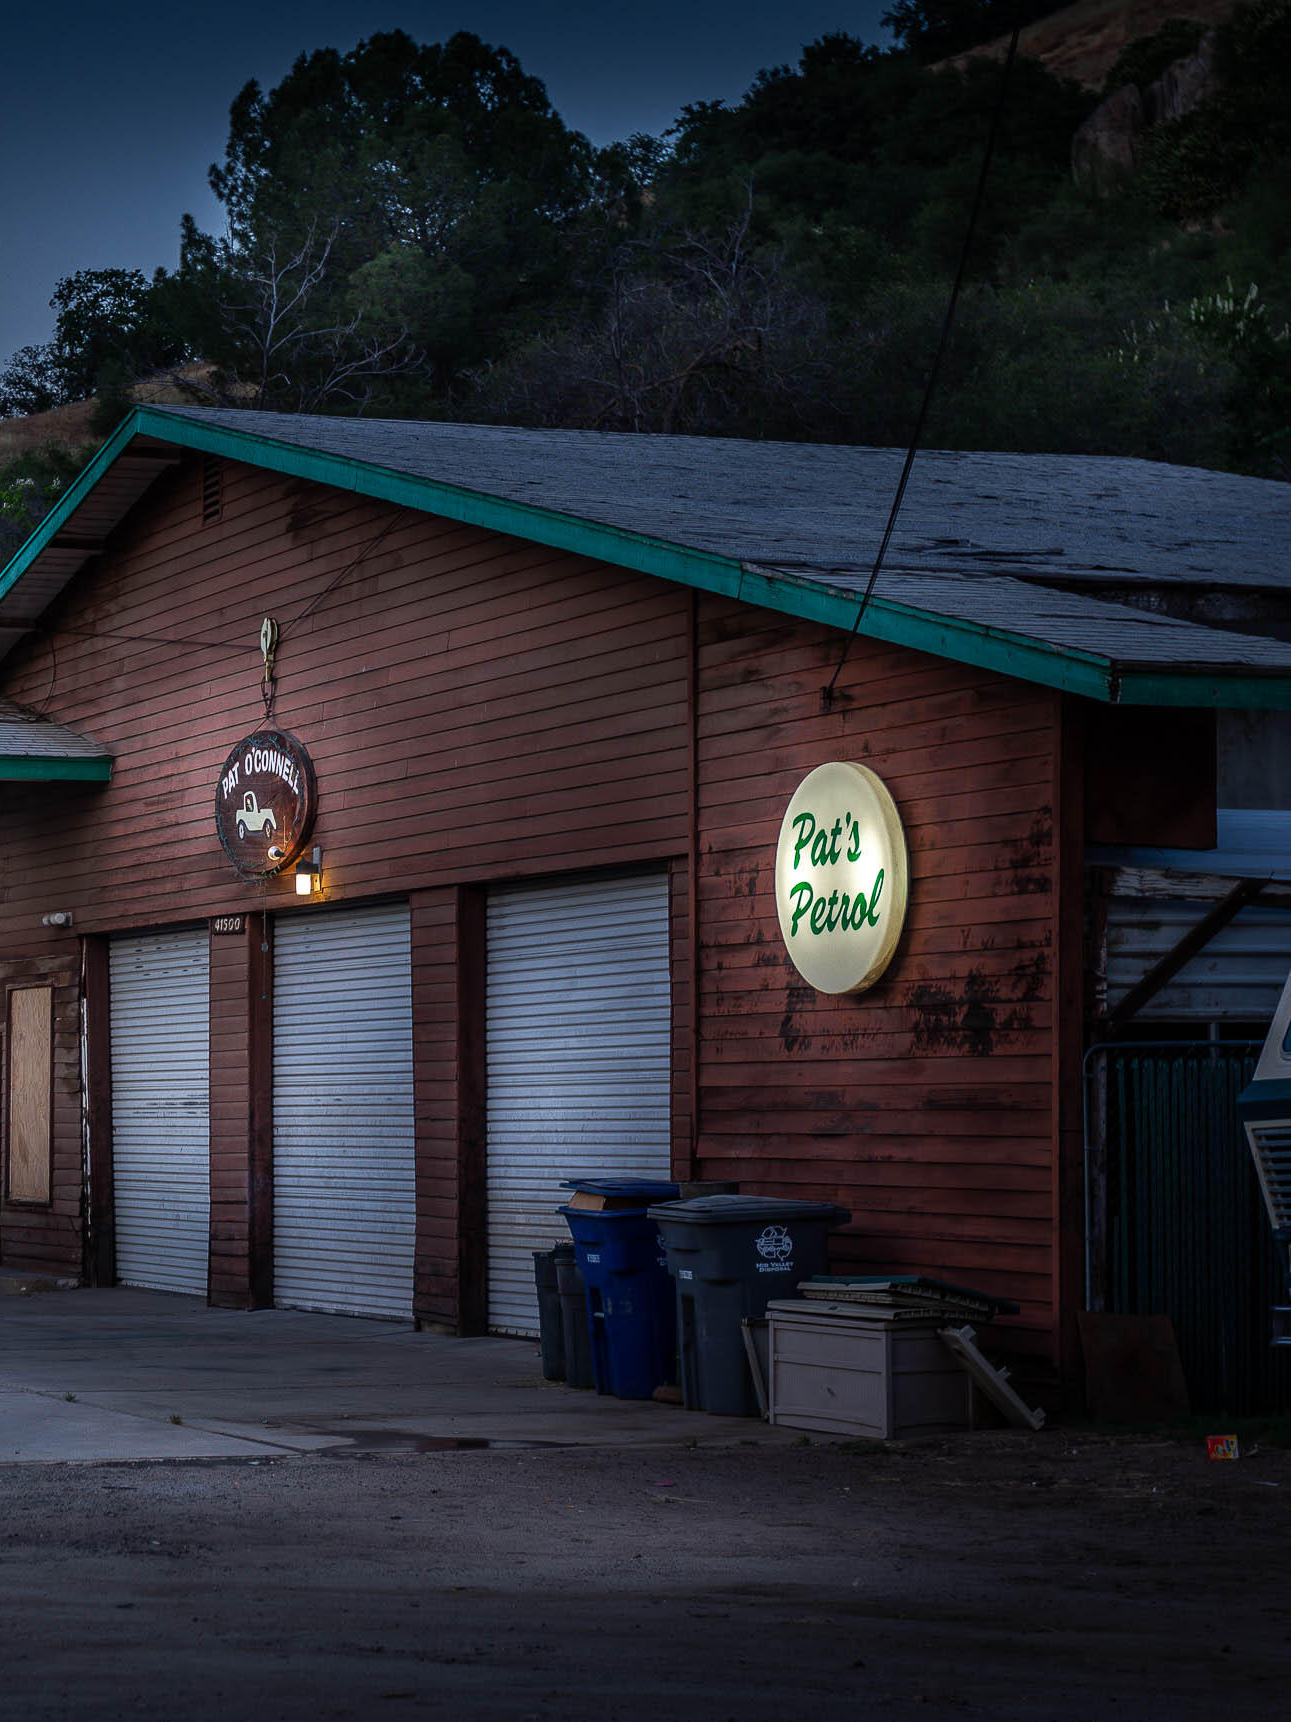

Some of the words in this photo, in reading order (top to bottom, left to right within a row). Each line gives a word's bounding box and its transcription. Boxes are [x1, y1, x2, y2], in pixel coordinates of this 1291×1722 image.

[221, 761, 240, 800] PAT
[244, 746, 300, 795] O'CONNELL
[792, 811, 862, 870] Pat's
[214, 917, 241, 931] 41500
[789, 868, 885, 937] Petrol
